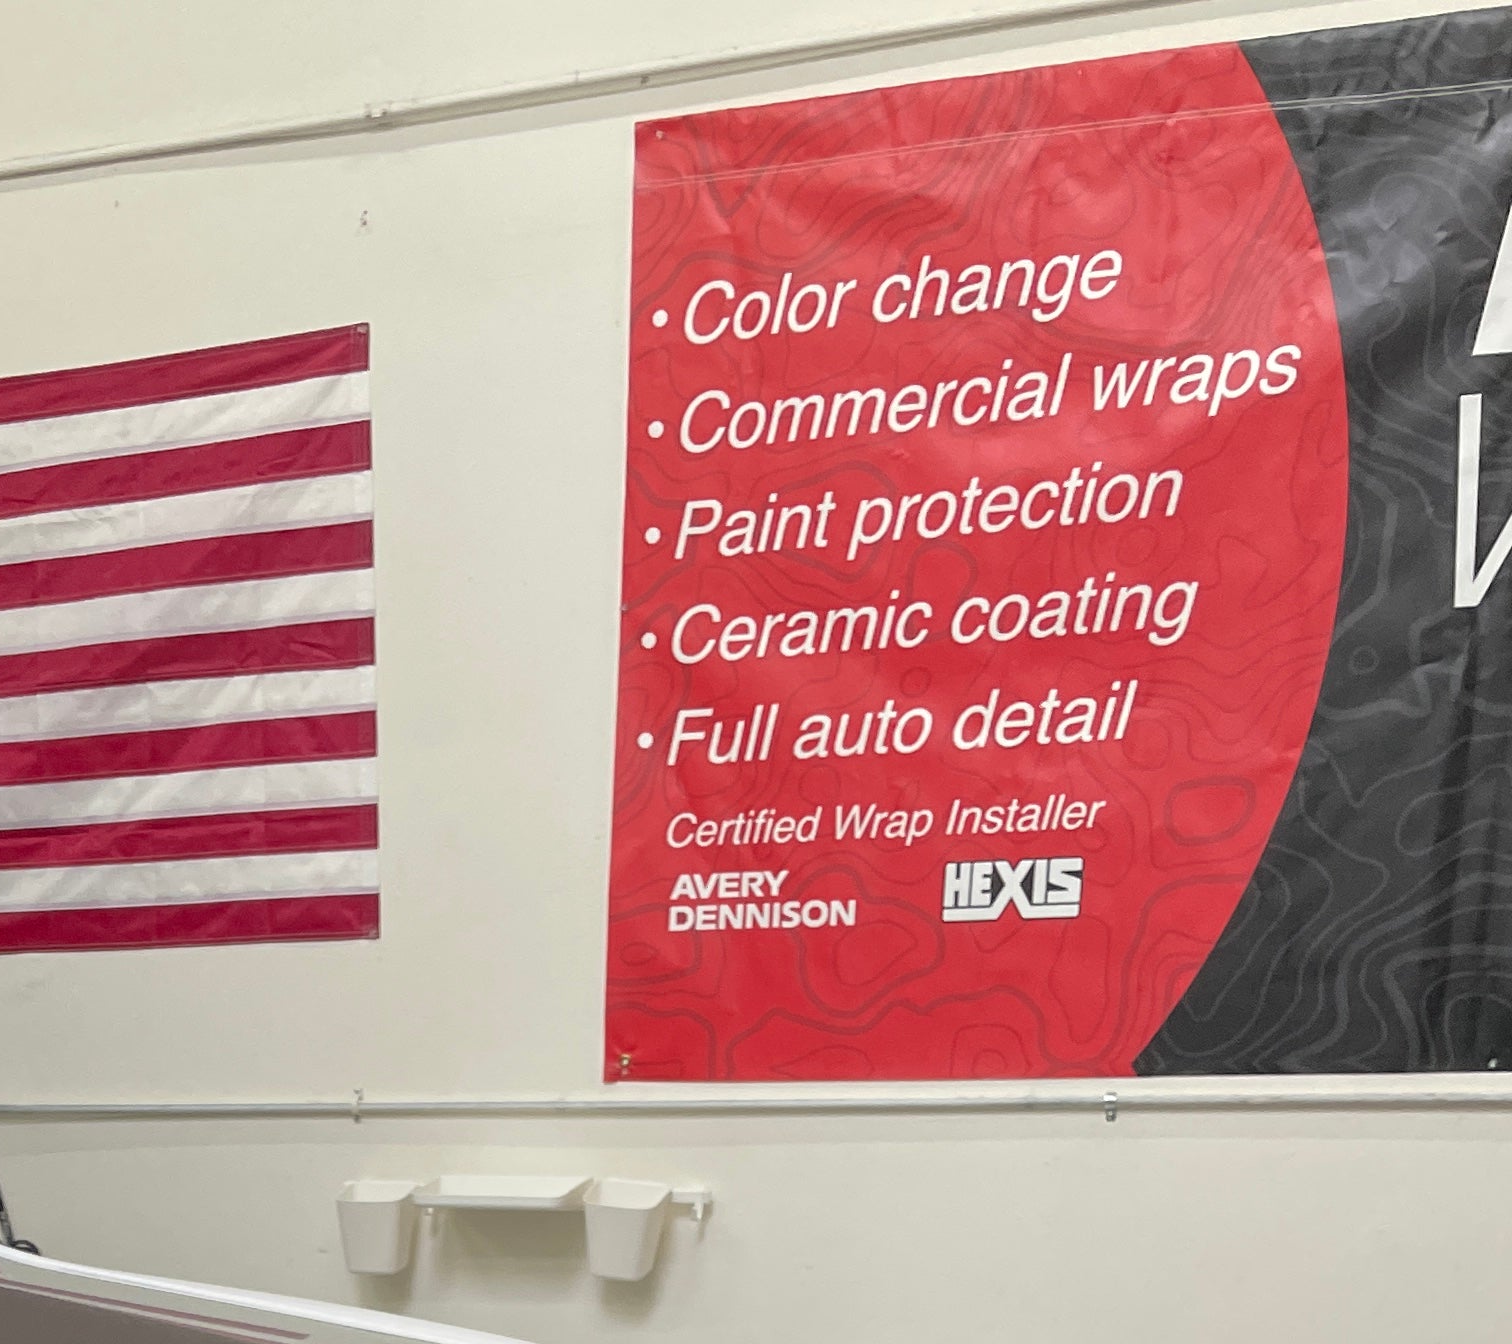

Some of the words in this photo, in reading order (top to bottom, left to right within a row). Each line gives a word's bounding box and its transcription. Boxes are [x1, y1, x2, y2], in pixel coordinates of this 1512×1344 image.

[684, 272, 858, 345] Color
[872, 249, 1123, 323] change
[680, 352, 1073, 454] Commercial
[1093, 344, 1302, 417] wraps
[674, 491, 837, 560] Paint
[847, 461, 1183, 561] protection
[672, 591, 933, 664] Ceramic
[951, 571, 1199, 646] coating
[667, 703, 779, 766] Full
[793, 699, 933, 759] auto
[953, 679, 1138, 750] detail
[667, 803, 823, 849] Certified
[835, 803, 934, 847] Wrap
[945, 793, 1107, 835] Installer
[668, 899, 857, 932] DENNISON
[670, 869, 790, 900] AVERY
[942, 857, 1085, 923] HEXIS
